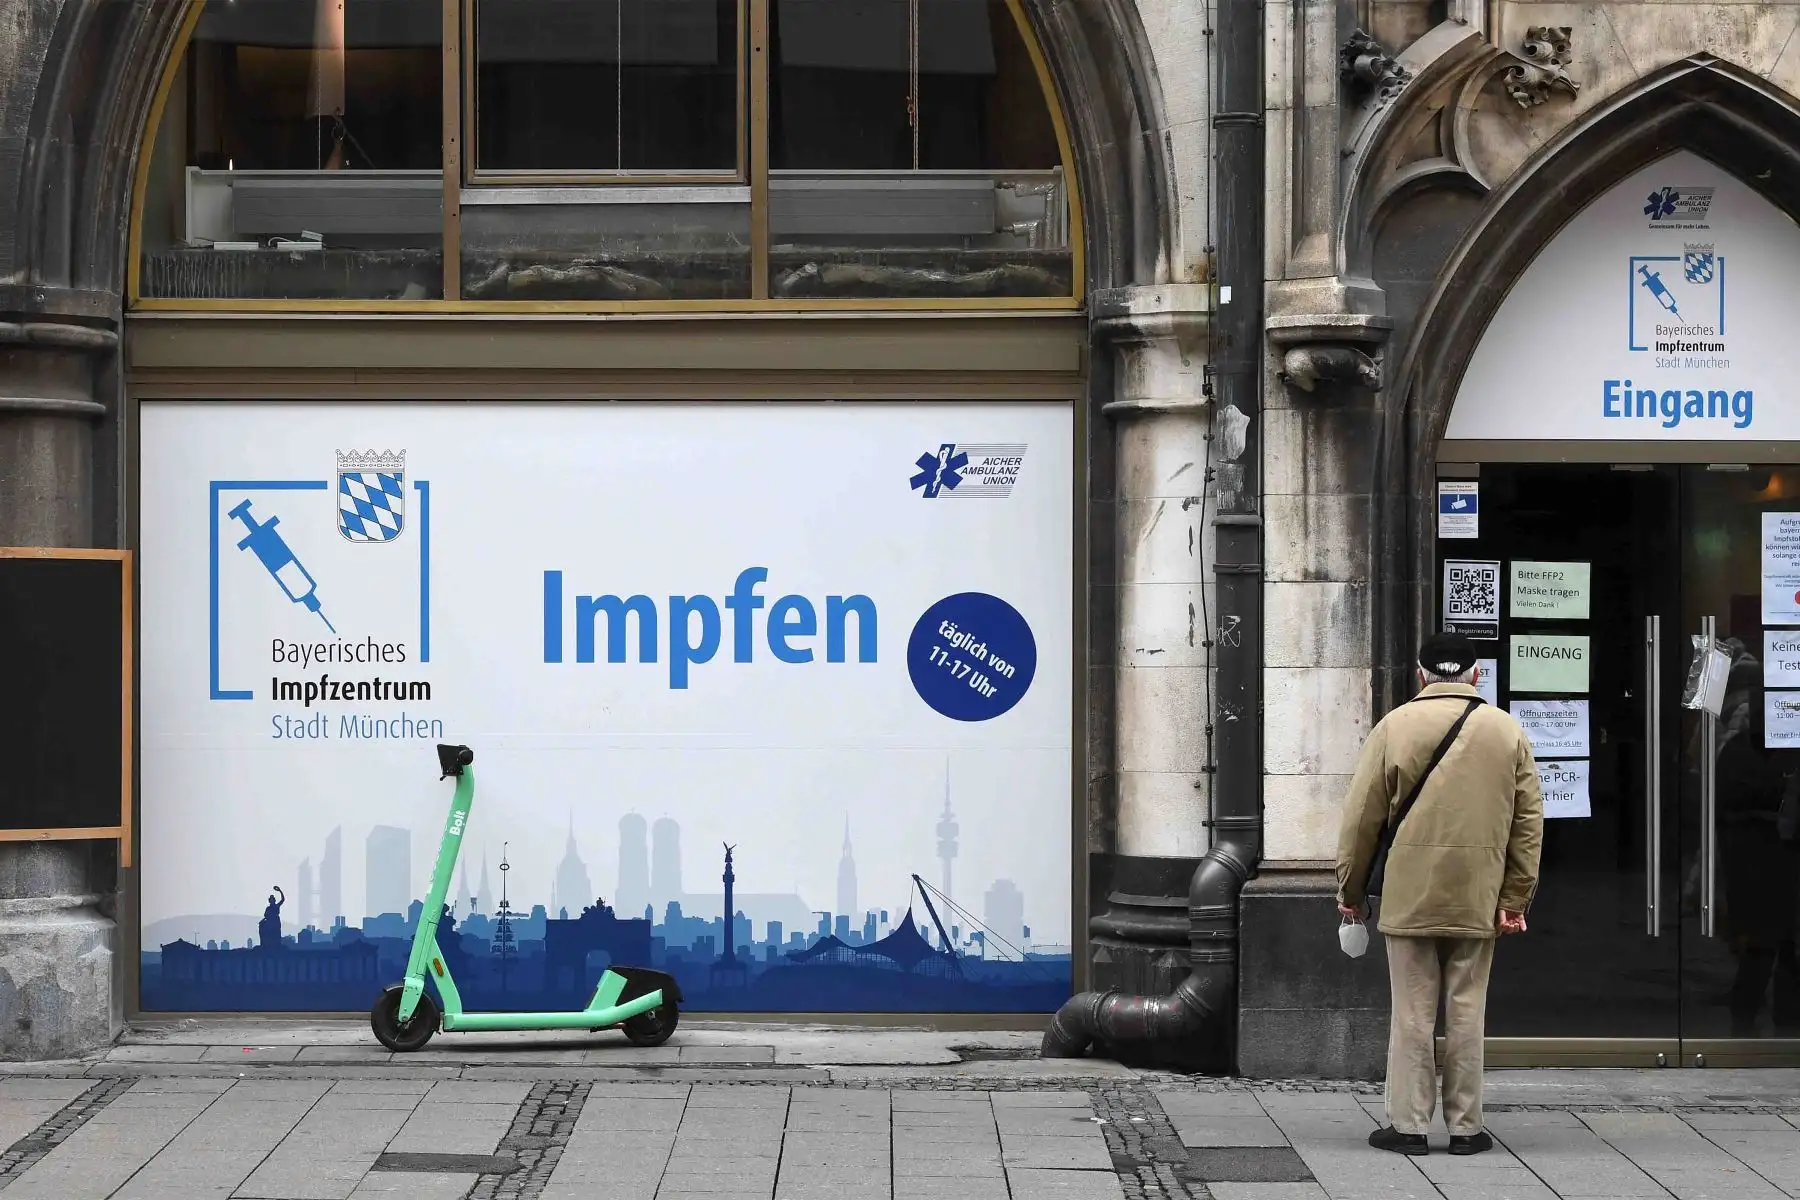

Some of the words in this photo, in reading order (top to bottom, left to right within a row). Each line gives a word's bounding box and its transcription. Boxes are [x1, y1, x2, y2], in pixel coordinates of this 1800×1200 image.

[1656, 324, 1714, 338] Bayerisches
[1656, 340, 1725, 354] Impfzentrum
[1656, 356, 1681, 368] Stadt
[1684, 356, 1730, 368] München
[1603, 379, 1753, 428] Eingang
[982, 457, 1022, 466] AICHER
[961, 466, 1020, 475] AMBULANZ
[982, 476, 1016, 485] UNION
[1518, 570, 1540, 580] Bitte
[1542, 571, 1564, 580] FFP2
[1517, 586, 1547, 596] Maske
[1550, 588, 1580, 598] tragen
[544, 566, 878, 689] Impfen
[272, 636, 406, 669] Bayerisches
[938, 620, 988, 660] täglich
[988, 654, 1016, 679] von
[1517, 646, 1582, 660] EINGANG
[930, 646, 972, 679] 11-17
[968, 671, 998, 698] Uhr
[272, 674, 432, 708] Impfzentrum
[1520, 708, 1578, 718] Öffnungszeiten
[272, 712, 328, 739] Stadt
[340, 712, 444, 739] München
[1554, 771, 1580, 782] PCR-
[1552, 790, 1575, 801] hier
[449, 810, 466, 836] Bolt
